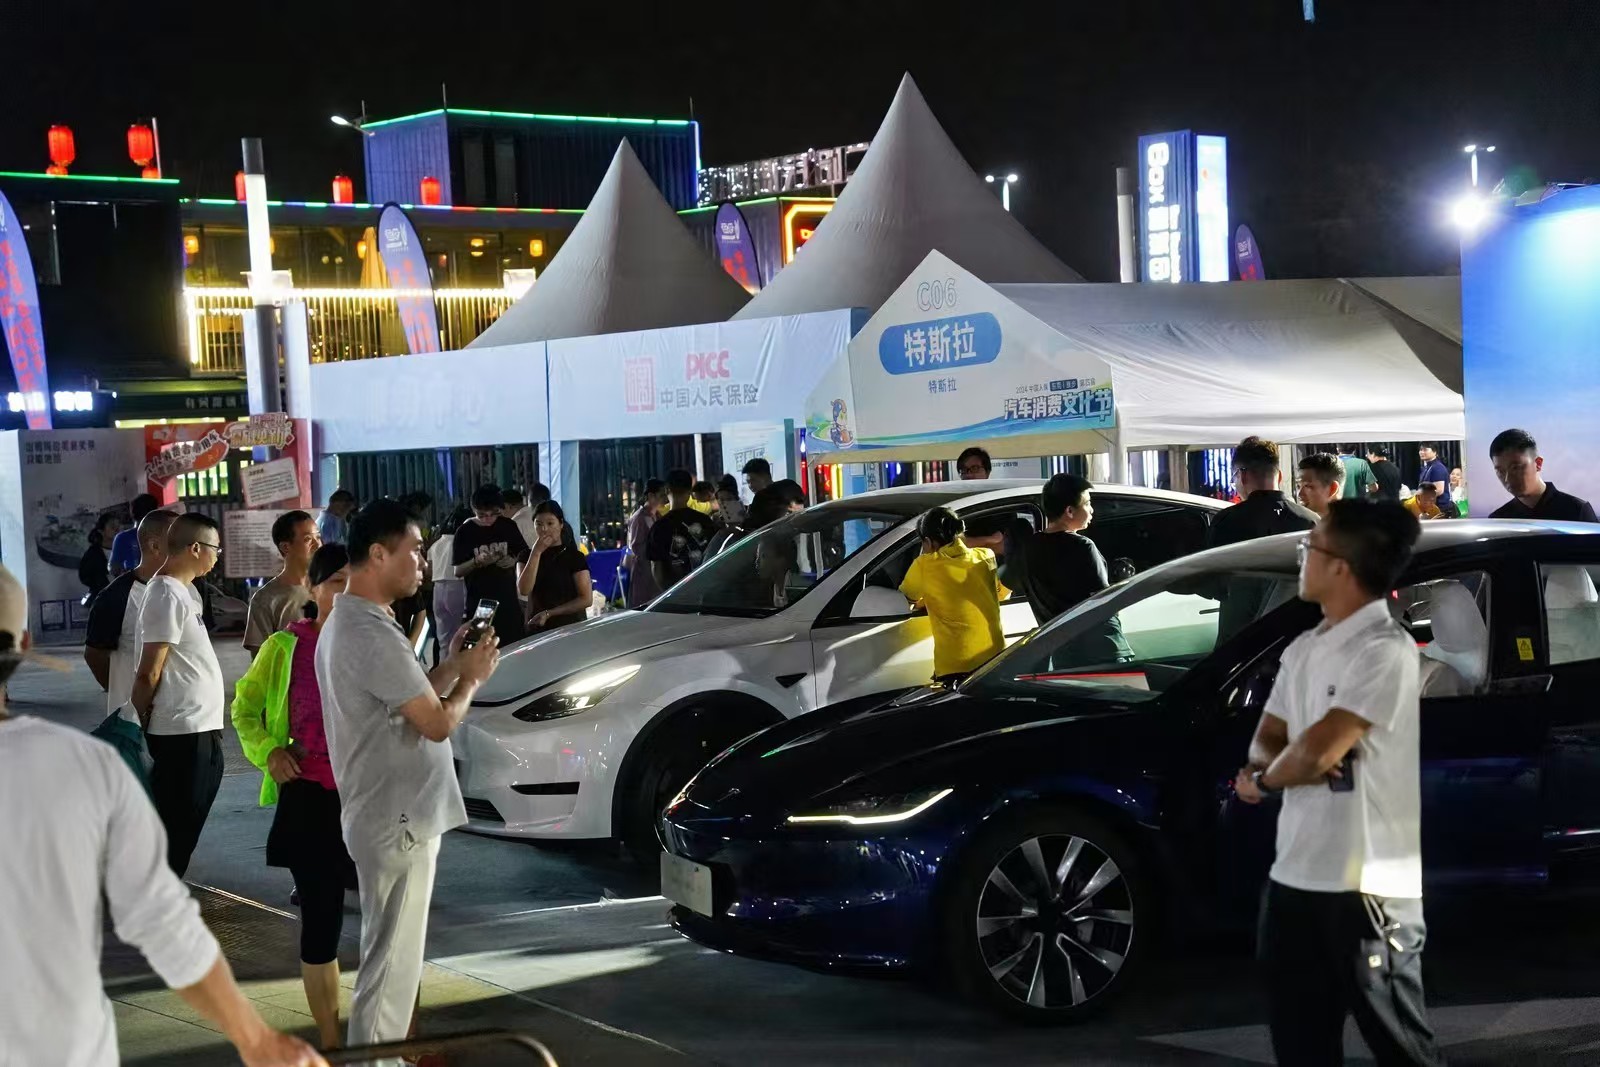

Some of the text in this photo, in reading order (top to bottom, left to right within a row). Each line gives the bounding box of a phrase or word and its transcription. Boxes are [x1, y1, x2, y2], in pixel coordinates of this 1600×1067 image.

[917, 276, 957, 311] C06
[904, 321, 977, 368] 特斯拉
[686, 350, 730, 381] PICC
[660, 383, 760, 409] 中国人民保险
[928, 378, 958, 395] 特斯拉
[1004, 388, 1112, 422] 汽车消费文化节
